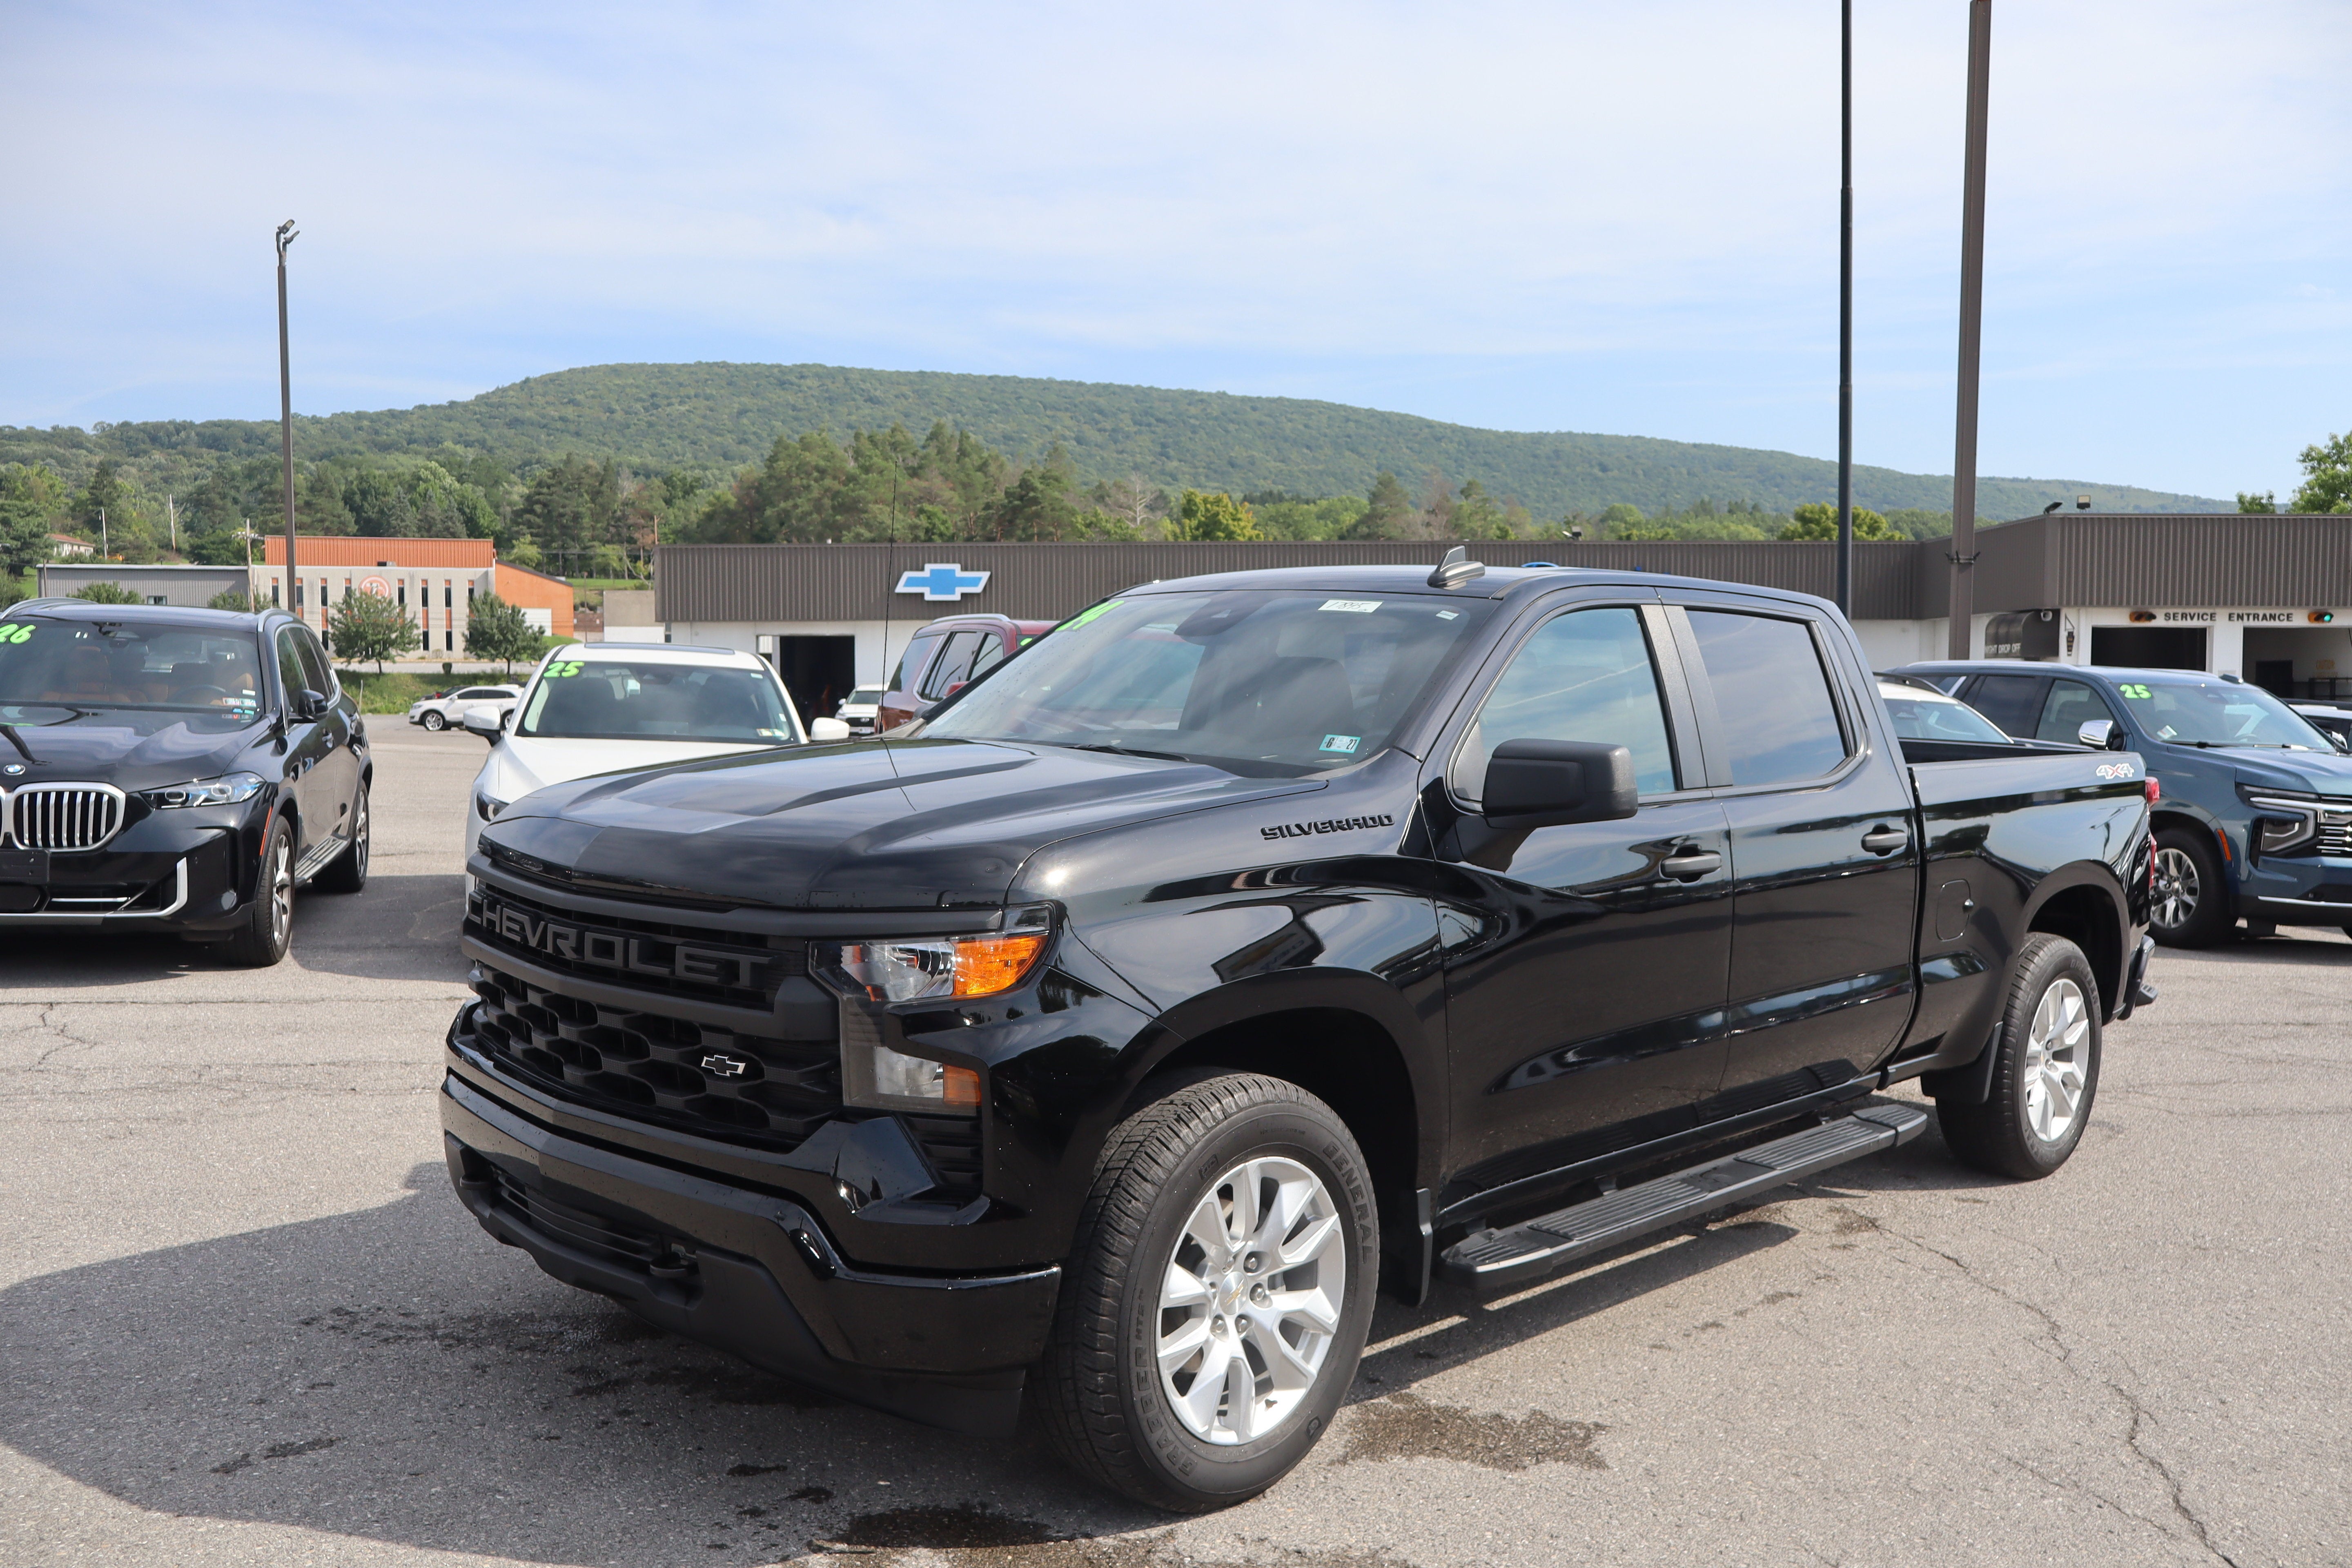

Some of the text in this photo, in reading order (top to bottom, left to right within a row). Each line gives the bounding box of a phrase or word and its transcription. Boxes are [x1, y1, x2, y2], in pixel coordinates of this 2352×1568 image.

[2164, 612, 2294, 622] SERVICE ENTRANCE
[0, 623, 36, 644] 26
[1998, 644, 2011, 653] DROP
[2011, 643, 2021, 653] OFF
[543, 661, 585, 677] 25
[2120, 684, 2152, 699] 25
[1326, 737, 1358, 751] 6 27
[1261, 813, 1395, 840] SILVERADO
[468, 893, 775, 987] CHEVROLET
[1322, 1141, 1373, 1264] GENERAL
[1136, 1346, 1197, 1476] GRABBER
